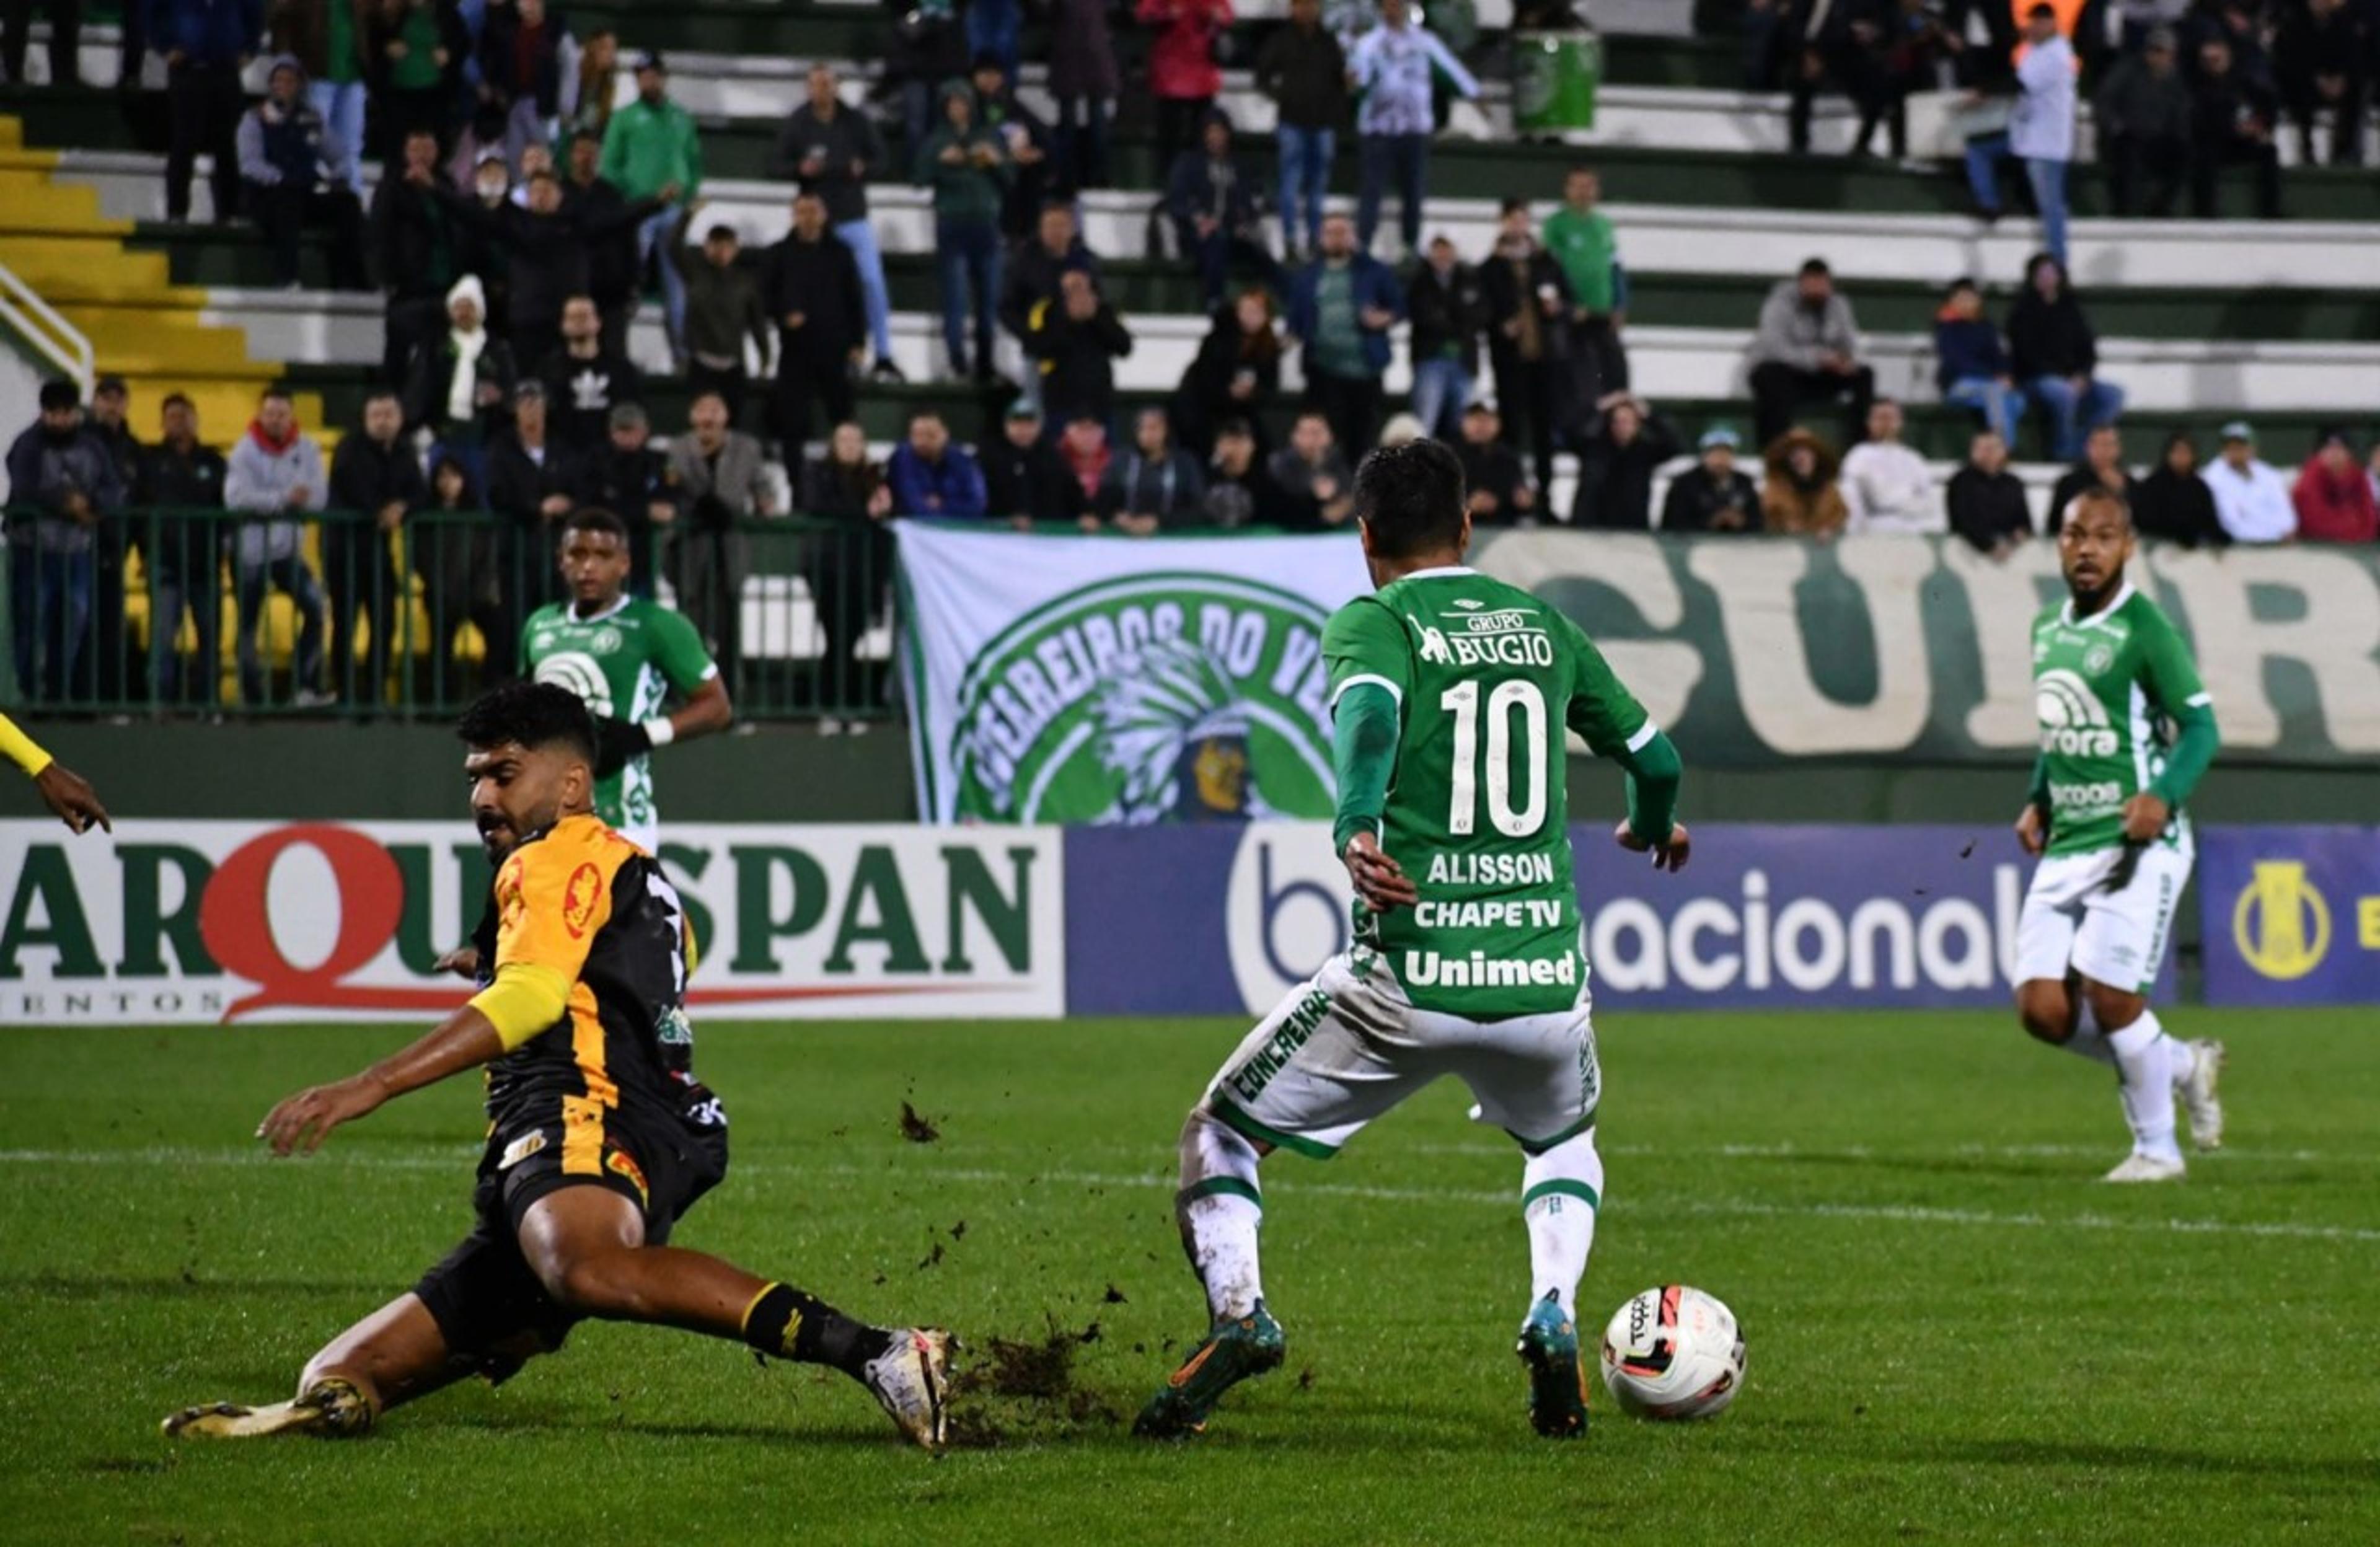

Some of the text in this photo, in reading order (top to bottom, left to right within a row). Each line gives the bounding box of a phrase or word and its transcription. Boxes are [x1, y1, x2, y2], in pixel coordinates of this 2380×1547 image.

[1200, 602, 1267, 679] DO
[1467, 614, 1524, 632] GRUPO
[1450, 633, 1553, 667] BUGIO
[1441, 679, 1546, 837] 10
[1427, 853, 1554, 885] ALISSON
[0, 819, 1037, 1001] ARQUSPAN
[1404, 950, 1576, 987] Unimed
